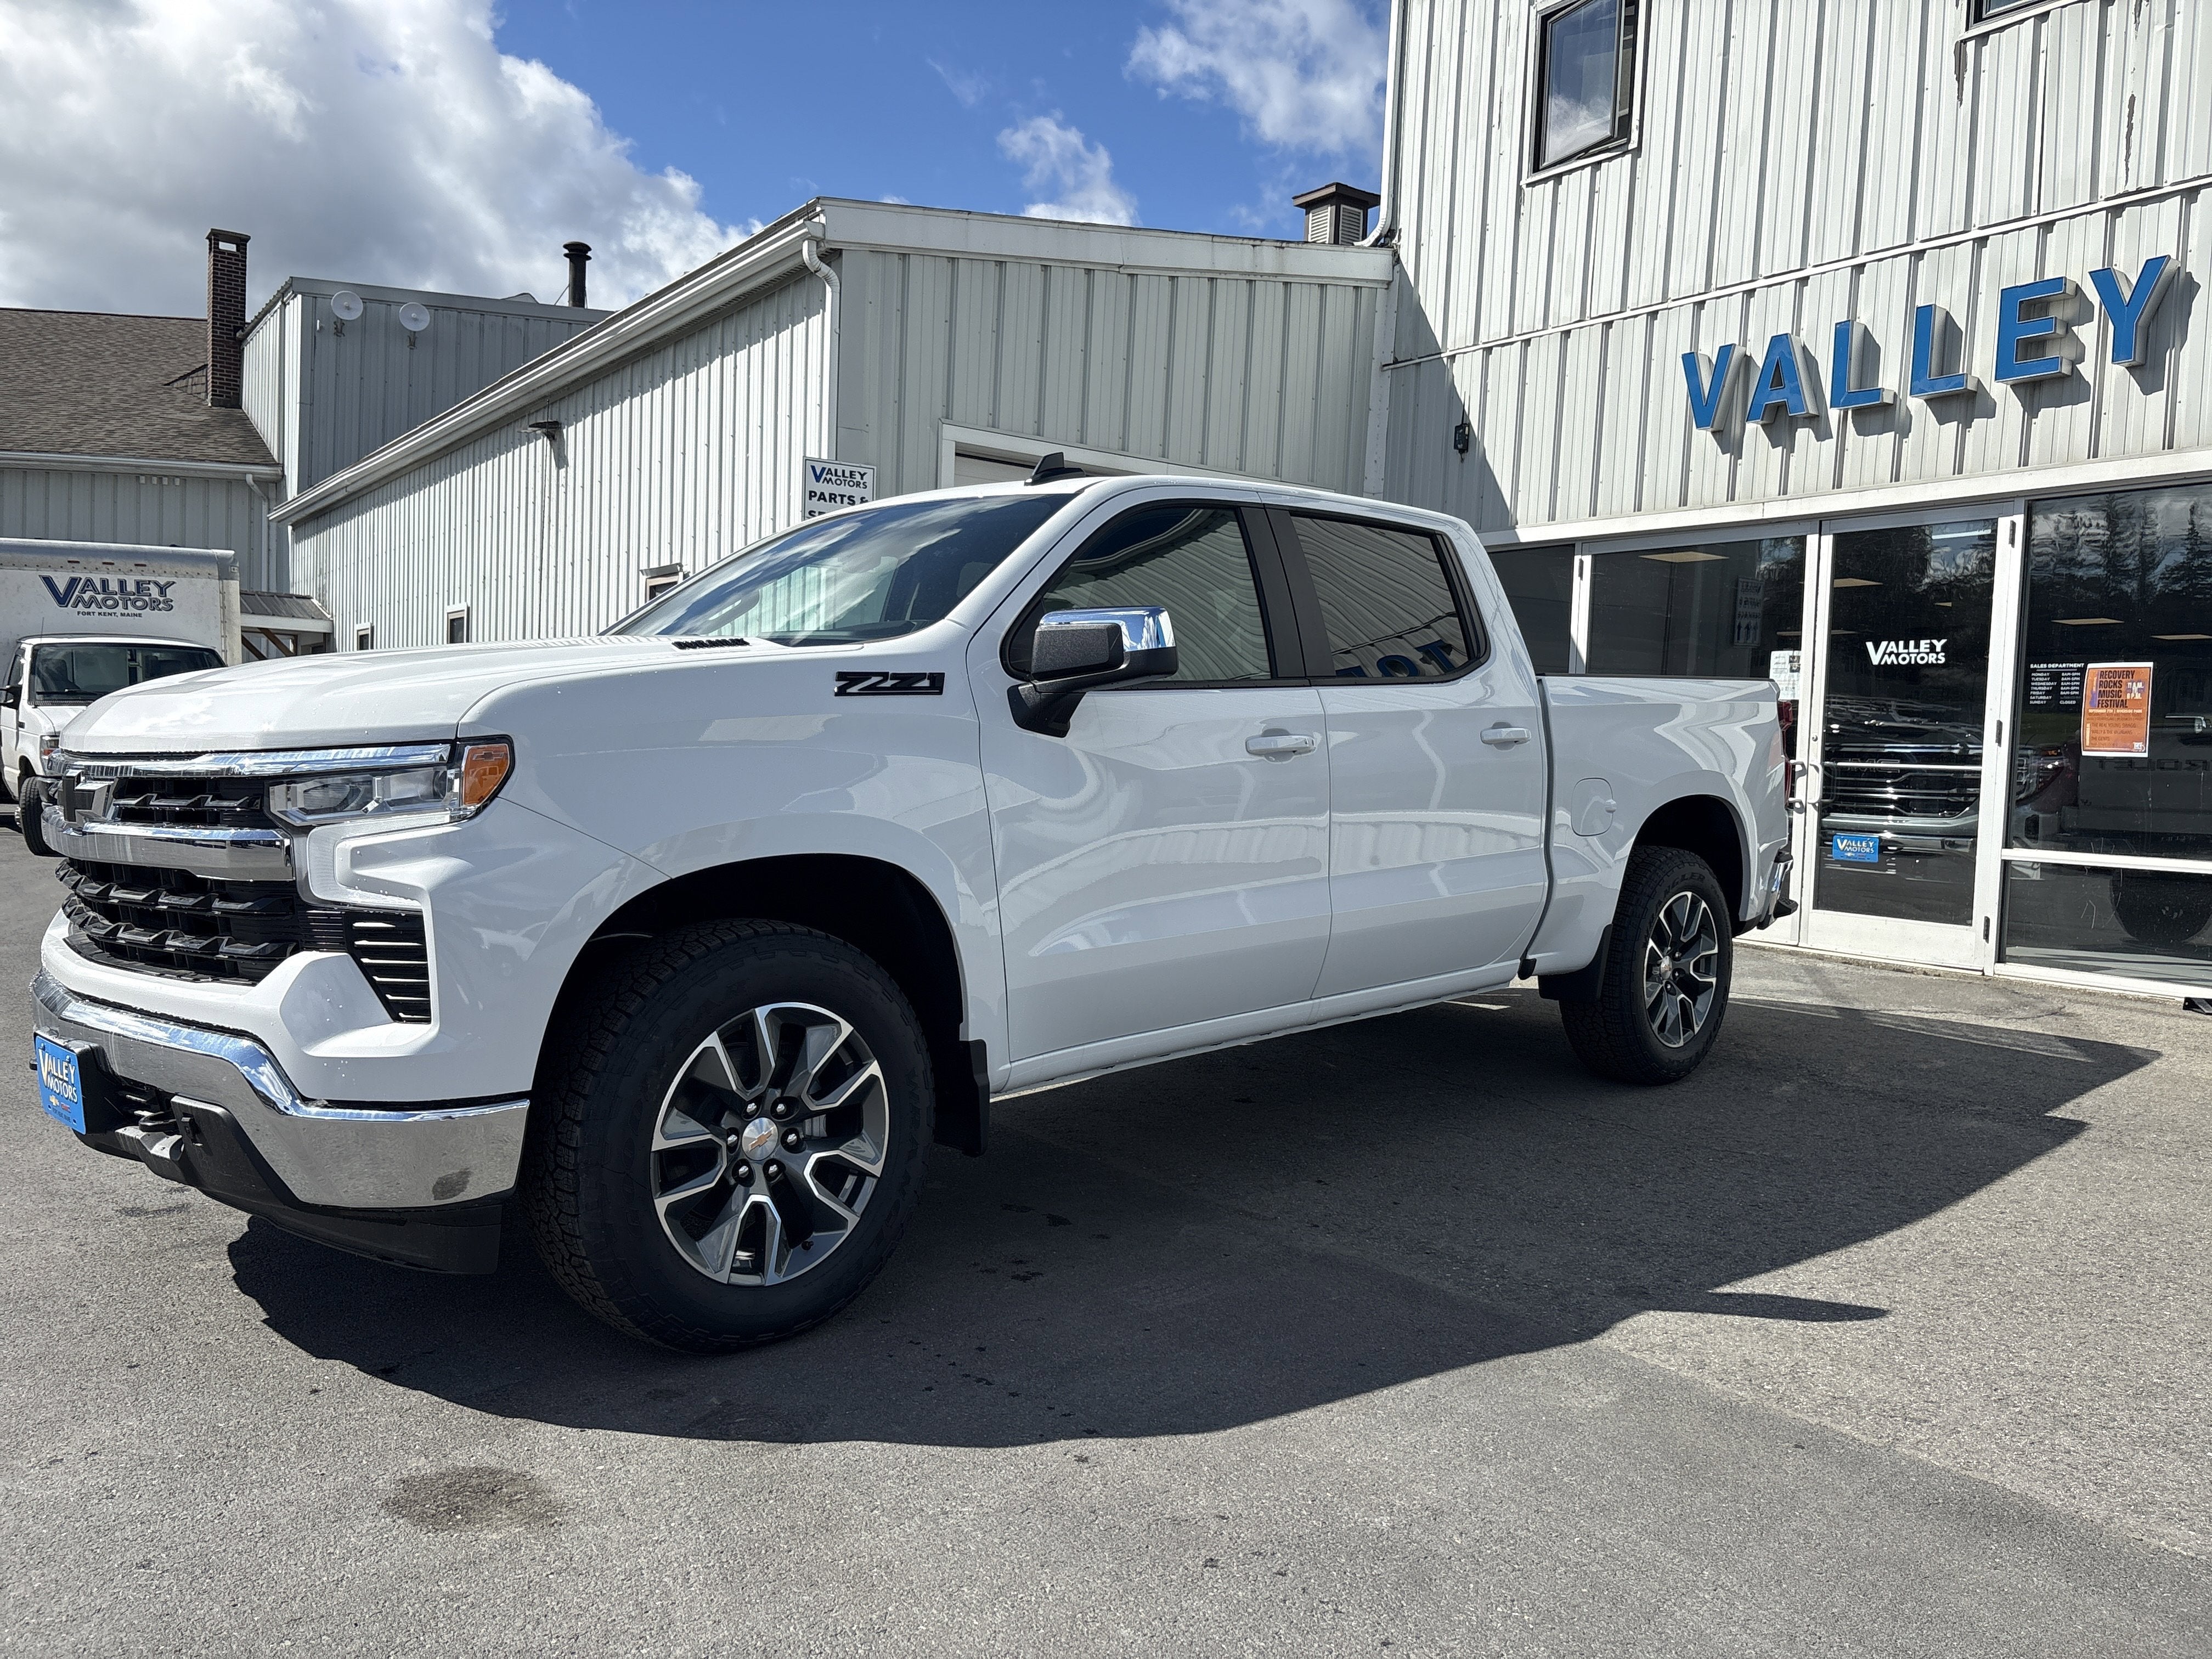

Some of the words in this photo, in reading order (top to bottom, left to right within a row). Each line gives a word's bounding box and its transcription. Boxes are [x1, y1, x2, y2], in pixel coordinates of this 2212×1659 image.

[1681, 255, 2181, 431] VALLEY
[810, 465, 867, 483] VALLEY
[822, 477, 867, 489] MOTORS
[809, 490, 856, 506] PARTS
[38, 575, 177, 607] VALLEY
[71, 595, 174, 611] MOTORS
[1865, 639, 1948, 665] VALLEY
[1880, 652, 1945, 665] MOTORS
[2100, 670, 2135, 679] RECOVERY
[834, 672, 945, 696] Z71
[2099, 680, 2123, 689] ROCKS
[2098, 690, 2122, 698] MUSIC
[2097, 699, 2128, 708] FESTIVAL
[1837, 838, 1875, 851] VALLEY
[38, 1048, 75, 1087] VALLEY
[48, 1075, 78, 1104] MOTORS
